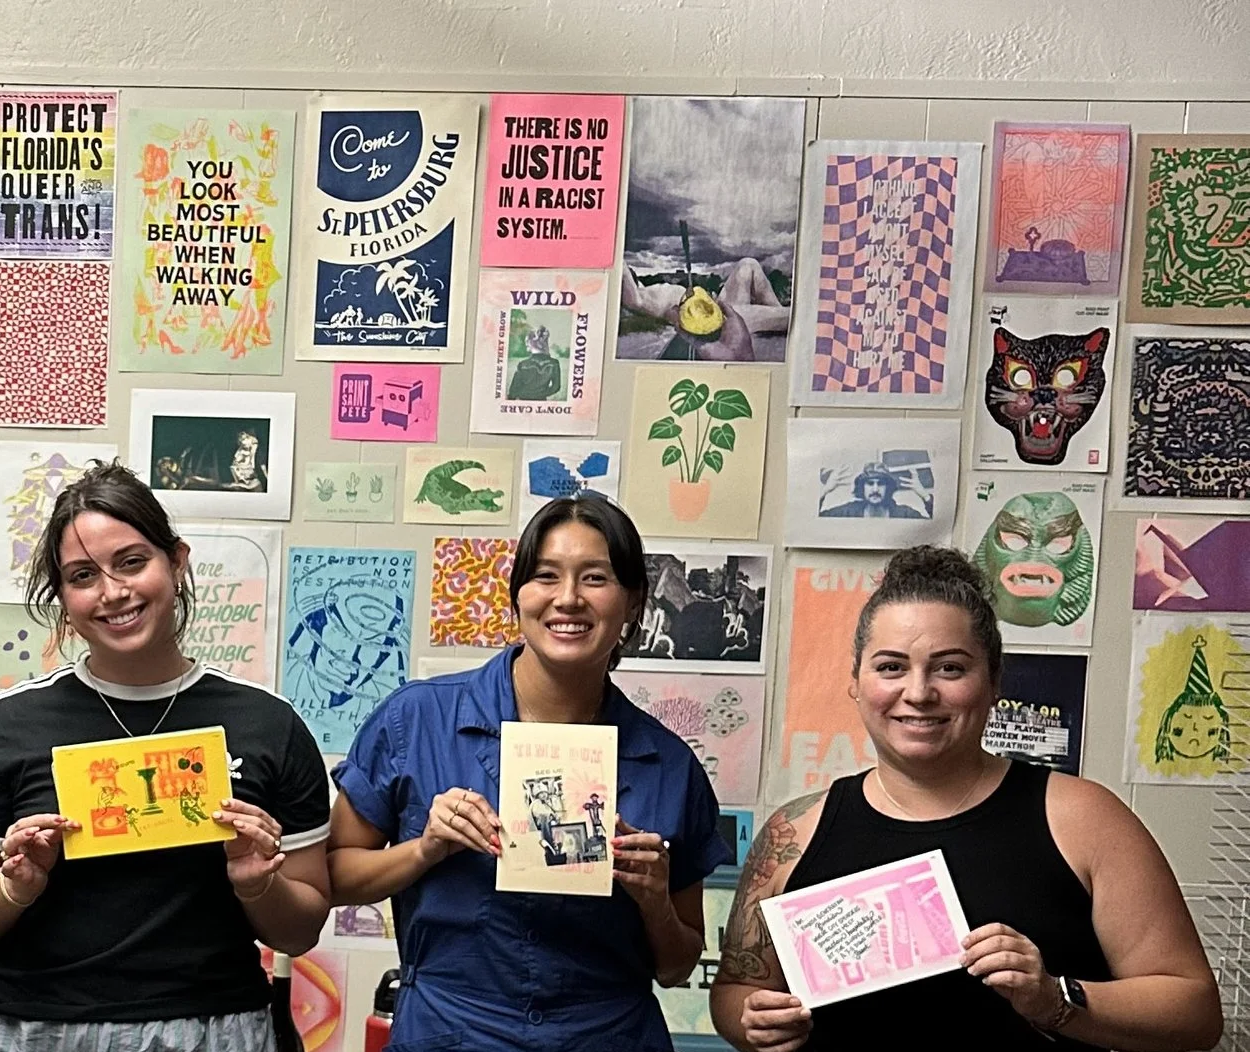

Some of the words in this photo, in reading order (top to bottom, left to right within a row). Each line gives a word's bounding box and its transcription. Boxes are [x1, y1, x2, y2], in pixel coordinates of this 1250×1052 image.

[2, 102, 107, 132] PROTECT
[504, 116, 561, 140] THERE
[564, 118, 582, 140] IS
[586, 118, 608, 140] NO
[2, 137, 102, 170] FLORIDA'S
[330, 125, 410, 172] Come
[186, 160, 233, 179] YOU
[367, 158, 392, 182] to
[502, 144, 604, 181] JUSTICE
[1, 173, 74, 200] QUEER
[180, 182, 237, 200] LOOK
[343, 133, 460, 237] PETERSBURG
[866, 180, 918, 197] NOTHING
[499, 187, 514, 208] IN
[518, 188, 530, 208] A
[535, 188, 605, 210] RACIST
[176, 204, 240, 222] MOST
[871, 202, 918, 219] ACCEPT
[0, 204, 101, 240] TRANS!
[496, 217, 568, 240] SYSTEM.
[868, 222, 909, 240] ABOUT
[148, 224, 266, 244] BEAUTIFUL
[350, 222, 429, 257] FLORIDA
[175, 246, 235, 264] WHEN
[864, 244, 910, 262] MYSELF
[156, 266, 253, 286] WALKING
[864, 266, 890, 283] CAN
[172, 288, 235, 307] AWAY
[510, 291, 576, 306] WILD
[869, 287, 898, 304] USED
[856, 308, 906, 326] AGAINST
[572, 312, 588, 398] FLOWERS
[341, 388, 368, 407] SAINT
[342, 380, 368, 400] PRINT
[341, 406, 367, 418] PETE
[500, 405, 532, 414] CARE
[536, 406, 572, 414] DON'T
[293, 554, 413, 565] RETRIBUTION
[373, 568, 411, 578] NOT
[984, 730, 1019, 740] LOWEEN
[1021, 734, 1047, 742] MOVIE
[1014, 725, 1046, 734] PLAYING
[985, 740, 1035, 750] MARATHON
